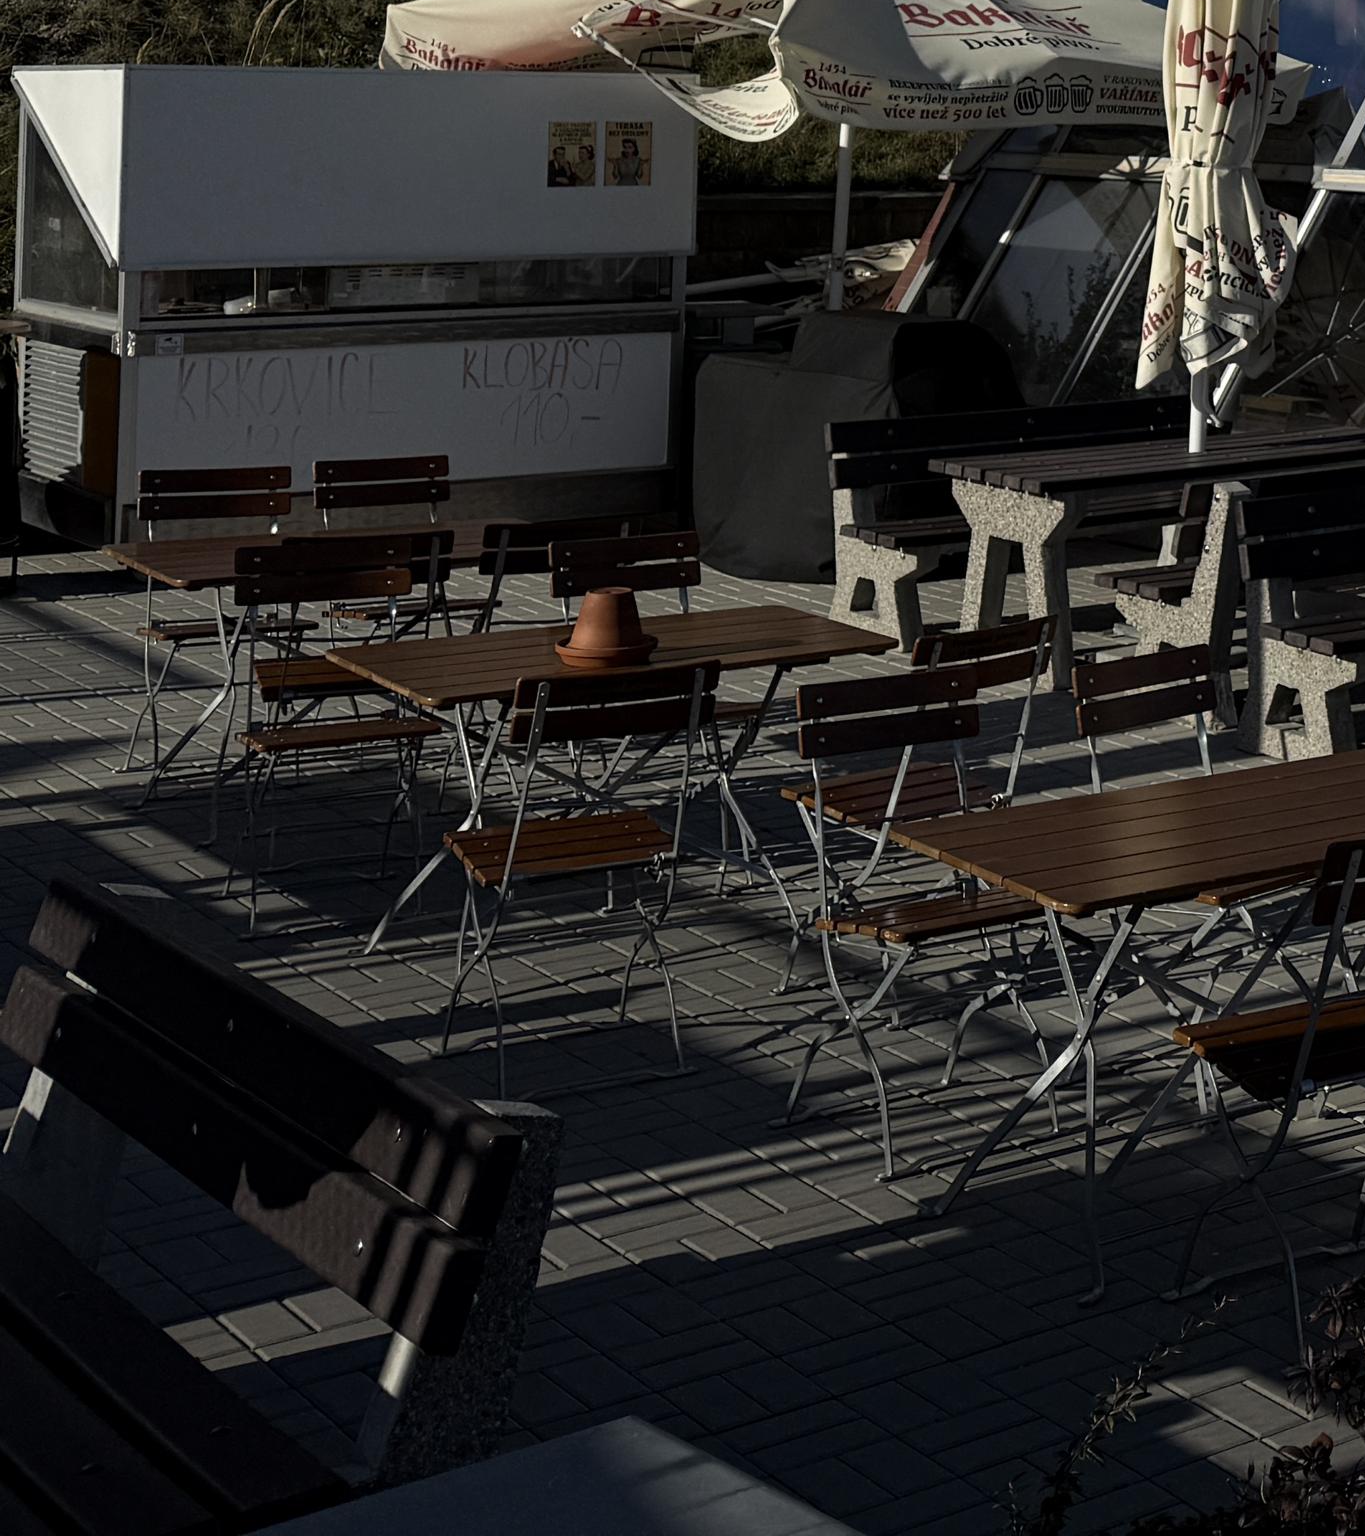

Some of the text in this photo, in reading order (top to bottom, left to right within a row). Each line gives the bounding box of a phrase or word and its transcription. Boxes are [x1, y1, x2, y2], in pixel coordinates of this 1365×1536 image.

[960, 32, 1101, 52] Dobré pivo.
[904, 92, 949, 106] vyvíjely
[951, 91, 1009, 107] nepřetržitě
[1100, 85, 1161, 103] VAŘÍME
[883, 103, 1007, 122] více než 500 let
[462, 337, 624, 391] KLOBÁSA
[174, 353, 399, 422] KRKOVICE
